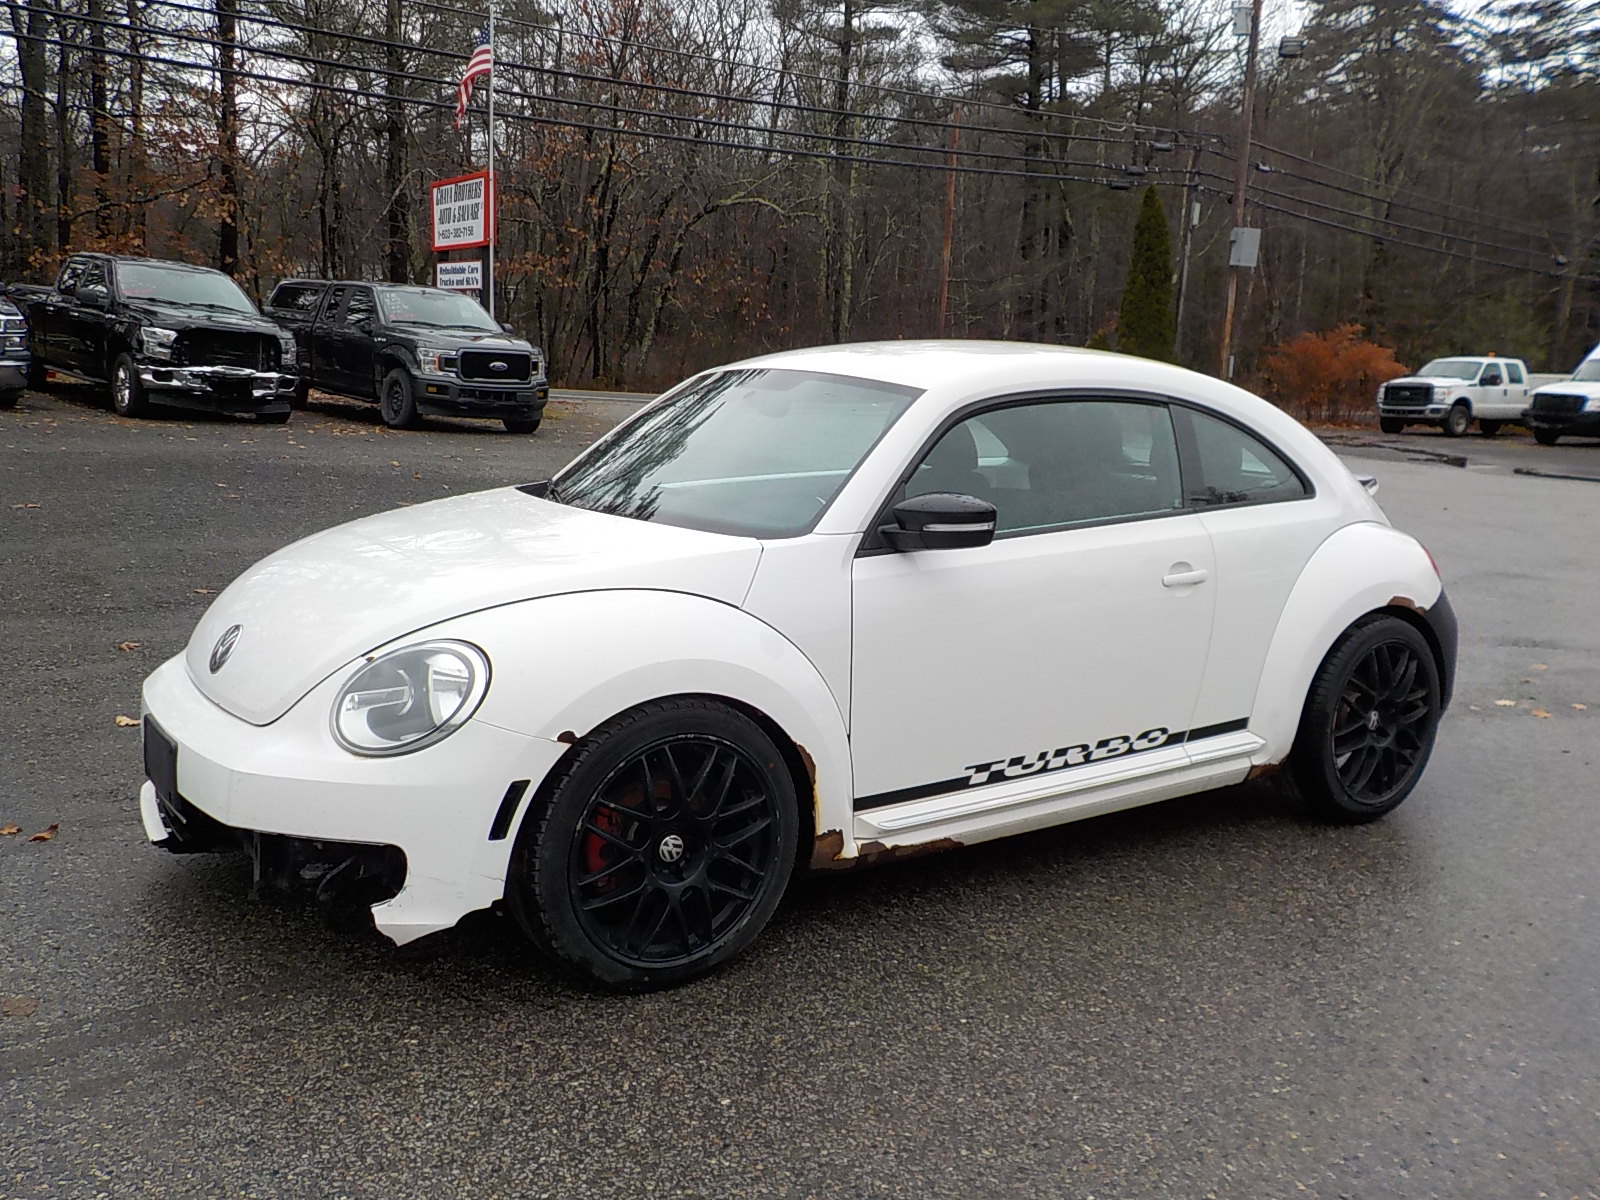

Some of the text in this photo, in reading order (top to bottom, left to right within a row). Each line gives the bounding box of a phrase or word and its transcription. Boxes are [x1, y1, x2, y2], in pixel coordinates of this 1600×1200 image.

[454, 181, 482, 203] BROTHERS
[438, 207, 452, 225] AUTO
[457, 202, 480, 222] SALVAGE
[440, 264, 479, 275] Rebuildable Cars
[440, 277, 455, 287] Trucks
[456, 277, 465, 286] and
[963, 726, 1170, 786] TURBO
